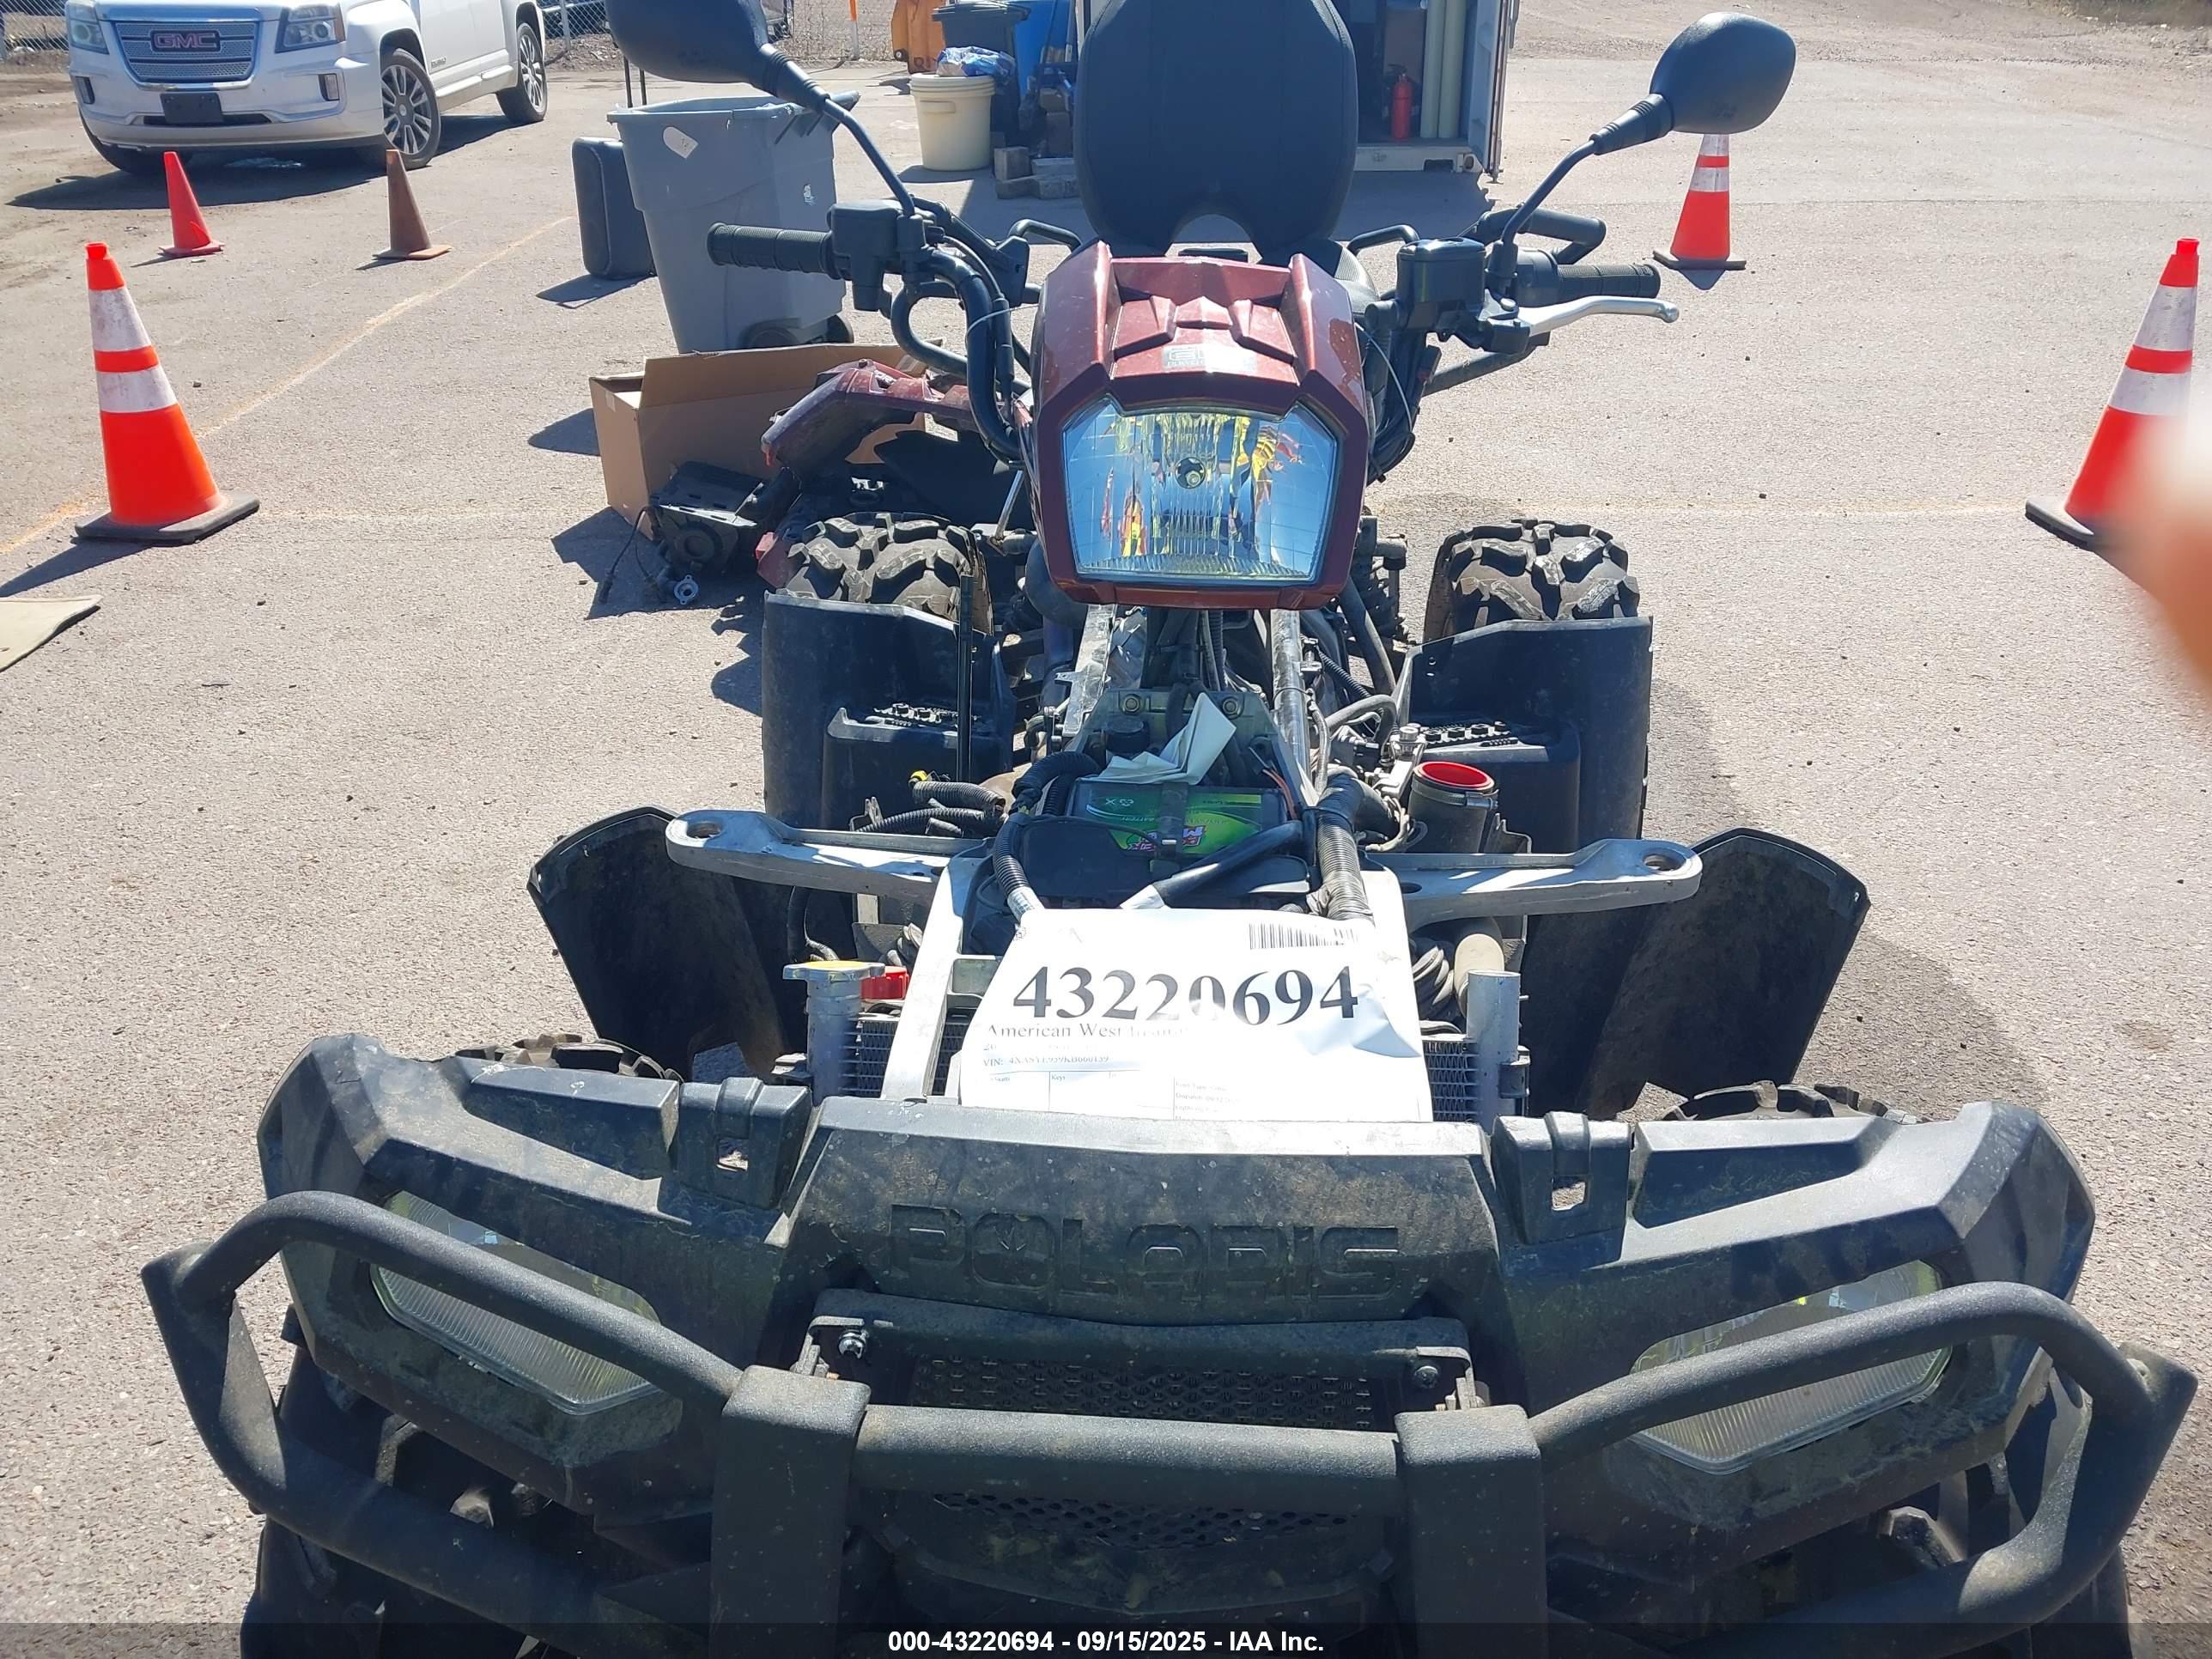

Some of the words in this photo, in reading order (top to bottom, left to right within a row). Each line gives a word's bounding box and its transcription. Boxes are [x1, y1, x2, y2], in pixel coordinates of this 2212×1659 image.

[153, 32, 218, 49] GMC
[1013, 966, 1358, 1025] 43220694
[988, 1024, 1072, 1037] American
[1079, 1023, 1122, 1037] West
[890, 1203, 1401, 1302] POLARIS
